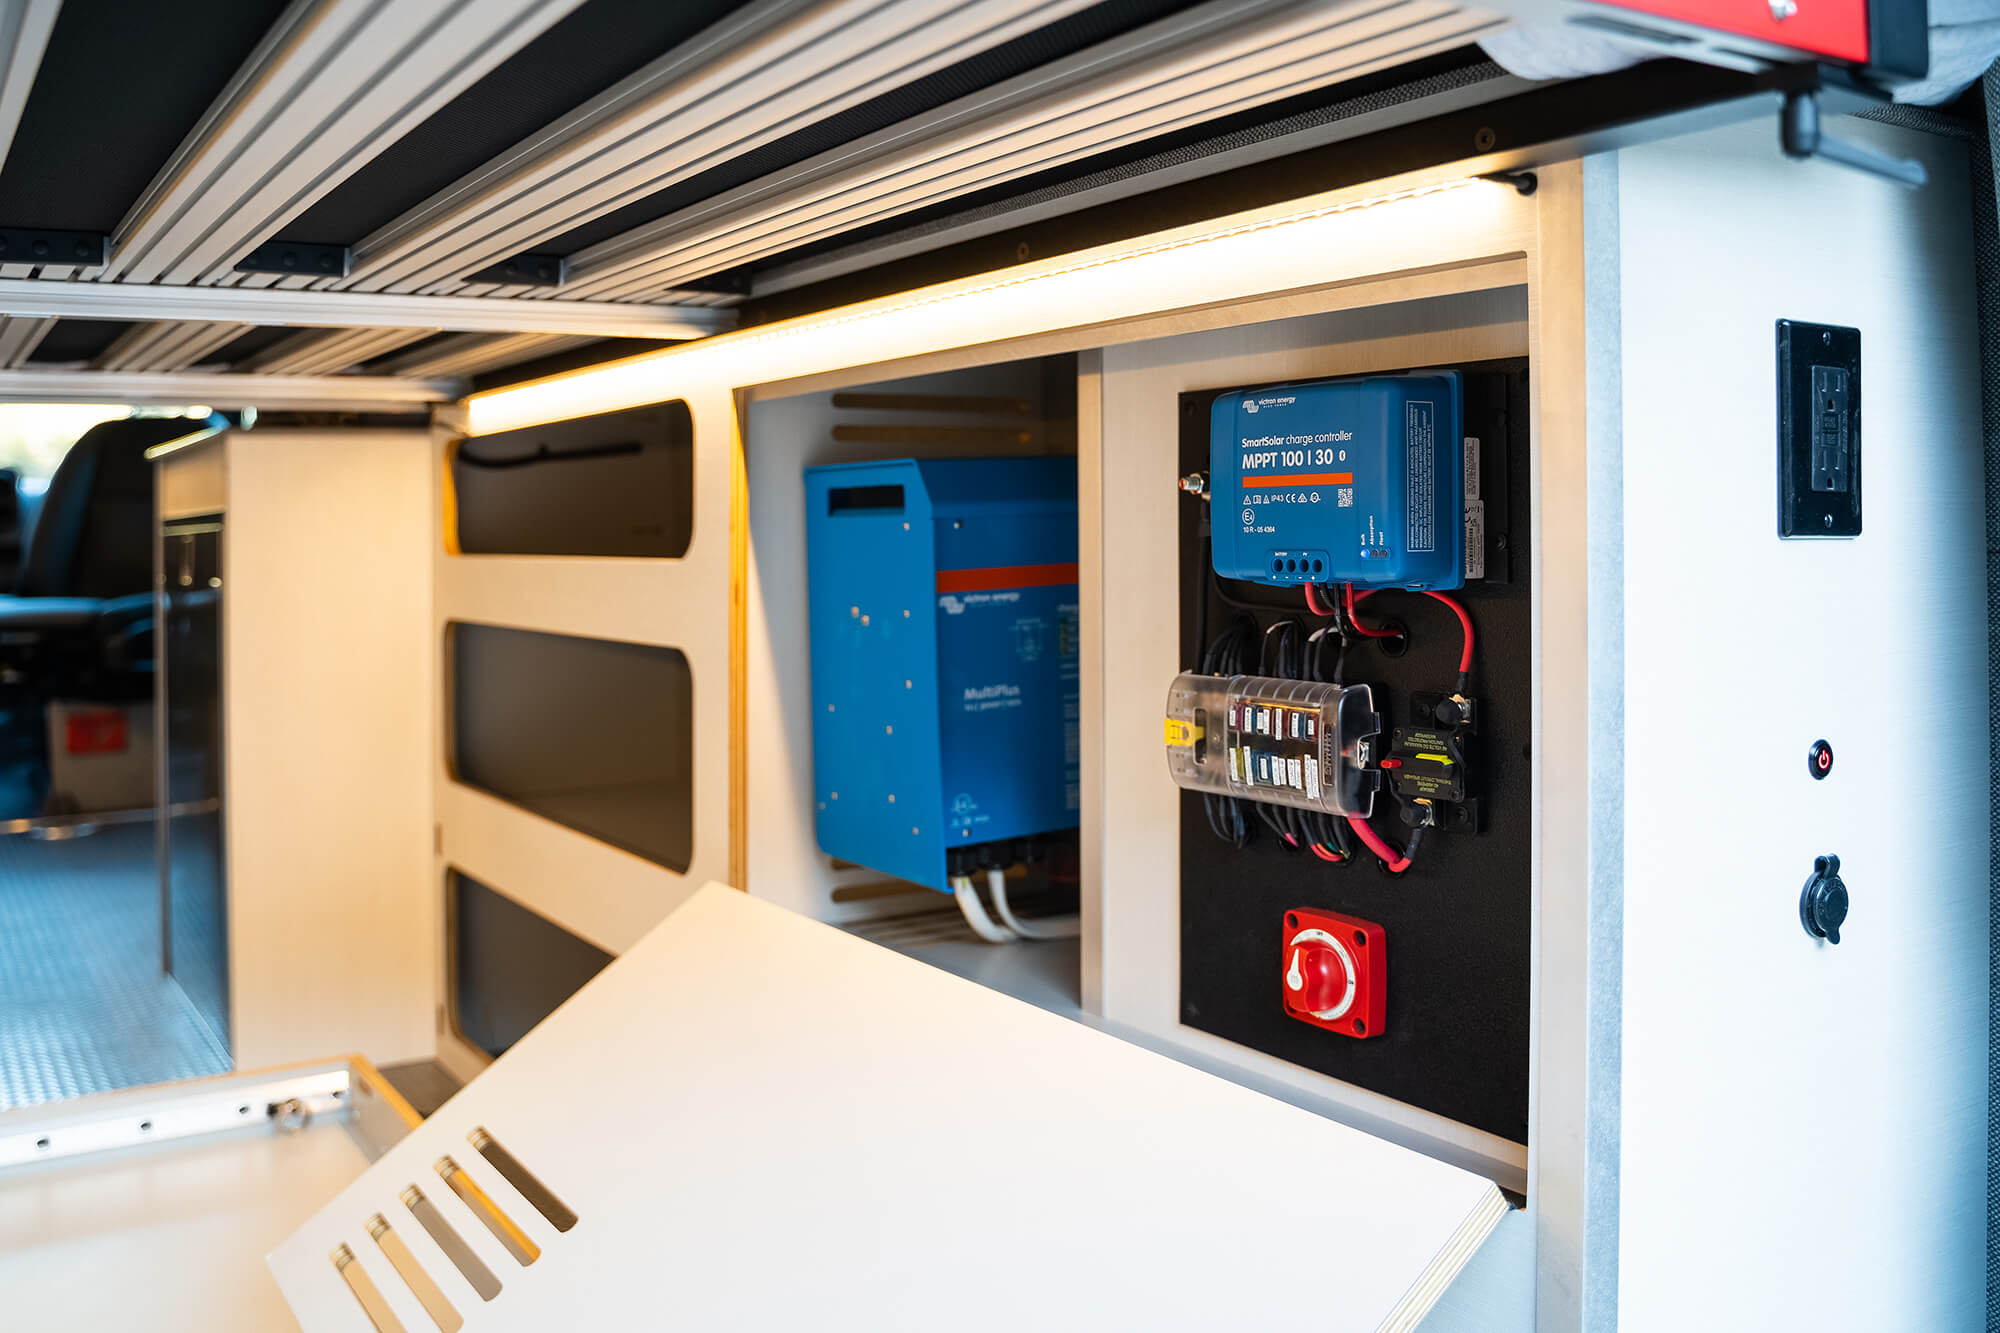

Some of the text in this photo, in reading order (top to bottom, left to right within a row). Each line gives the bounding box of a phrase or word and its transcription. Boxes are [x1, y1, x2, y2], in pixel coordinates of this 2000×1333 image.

[1277, 396, 1296, 404] energy
[1241, 430, 1352, 448] SmartSolar charge controller
[1242, 452, 1278, 470] MPPT
[1281, 450, 1304, 468] 100
[1315, 448, 1334, 466] 30
